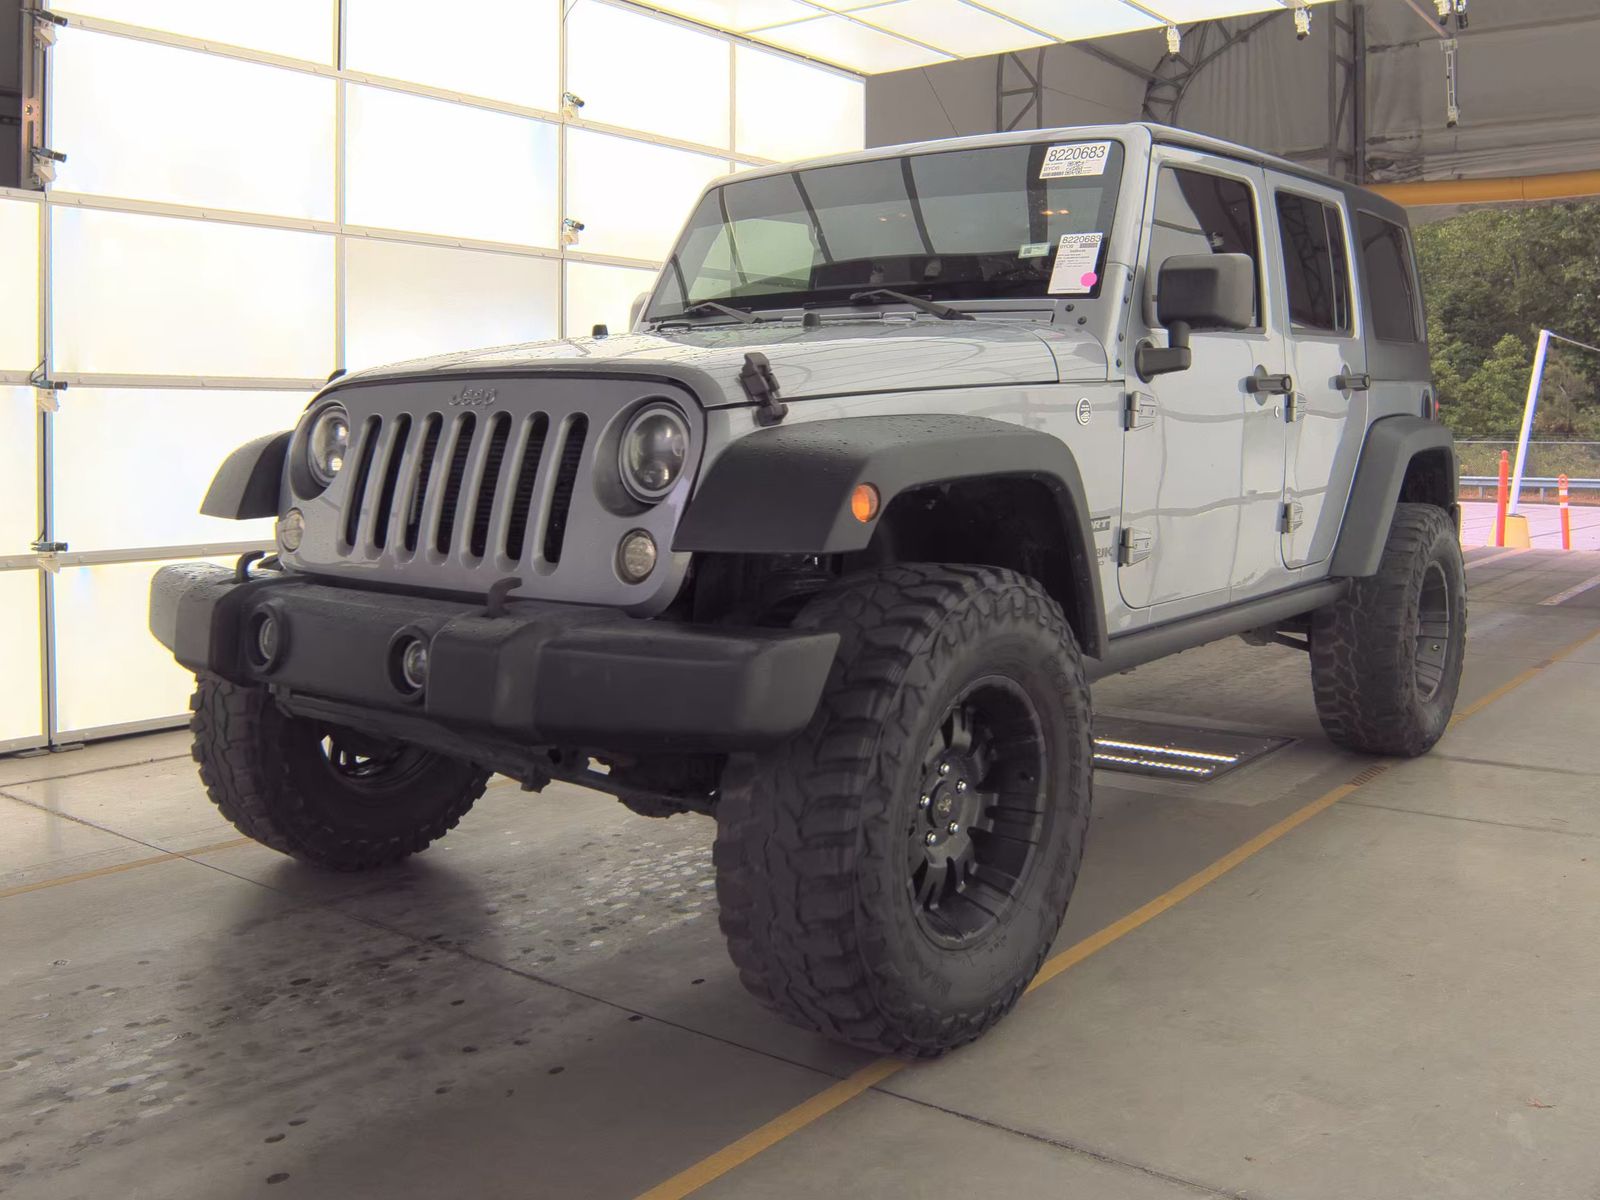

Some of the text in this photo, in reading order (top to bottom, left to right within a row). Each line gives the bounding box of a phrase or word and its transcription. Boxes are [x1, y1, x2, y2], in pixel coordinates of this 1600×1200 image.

[1048, 145, 1106, 162] 8220683
[1062, 234, 1101, 244] 8220683
[448, 385, 497, 409] Jeep
